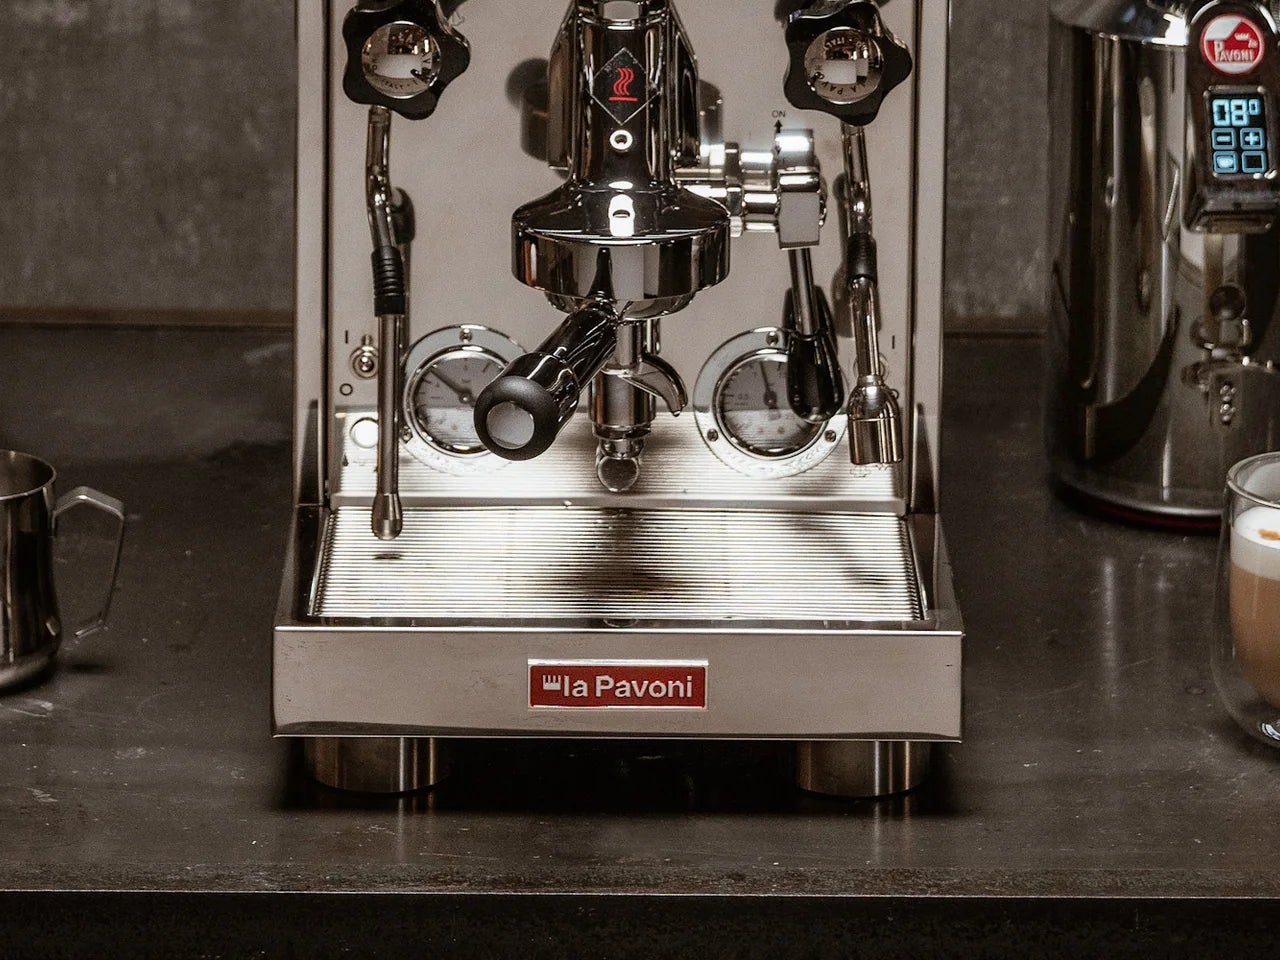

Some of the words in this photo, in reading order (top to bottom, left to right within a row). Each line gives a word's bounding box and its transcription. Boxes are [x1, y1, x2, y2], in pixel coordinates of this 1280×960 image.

[771, 110, 786, 119] ON
[563, 675, 588, 697] la
[595, 675, 693, 698] Pavoni
